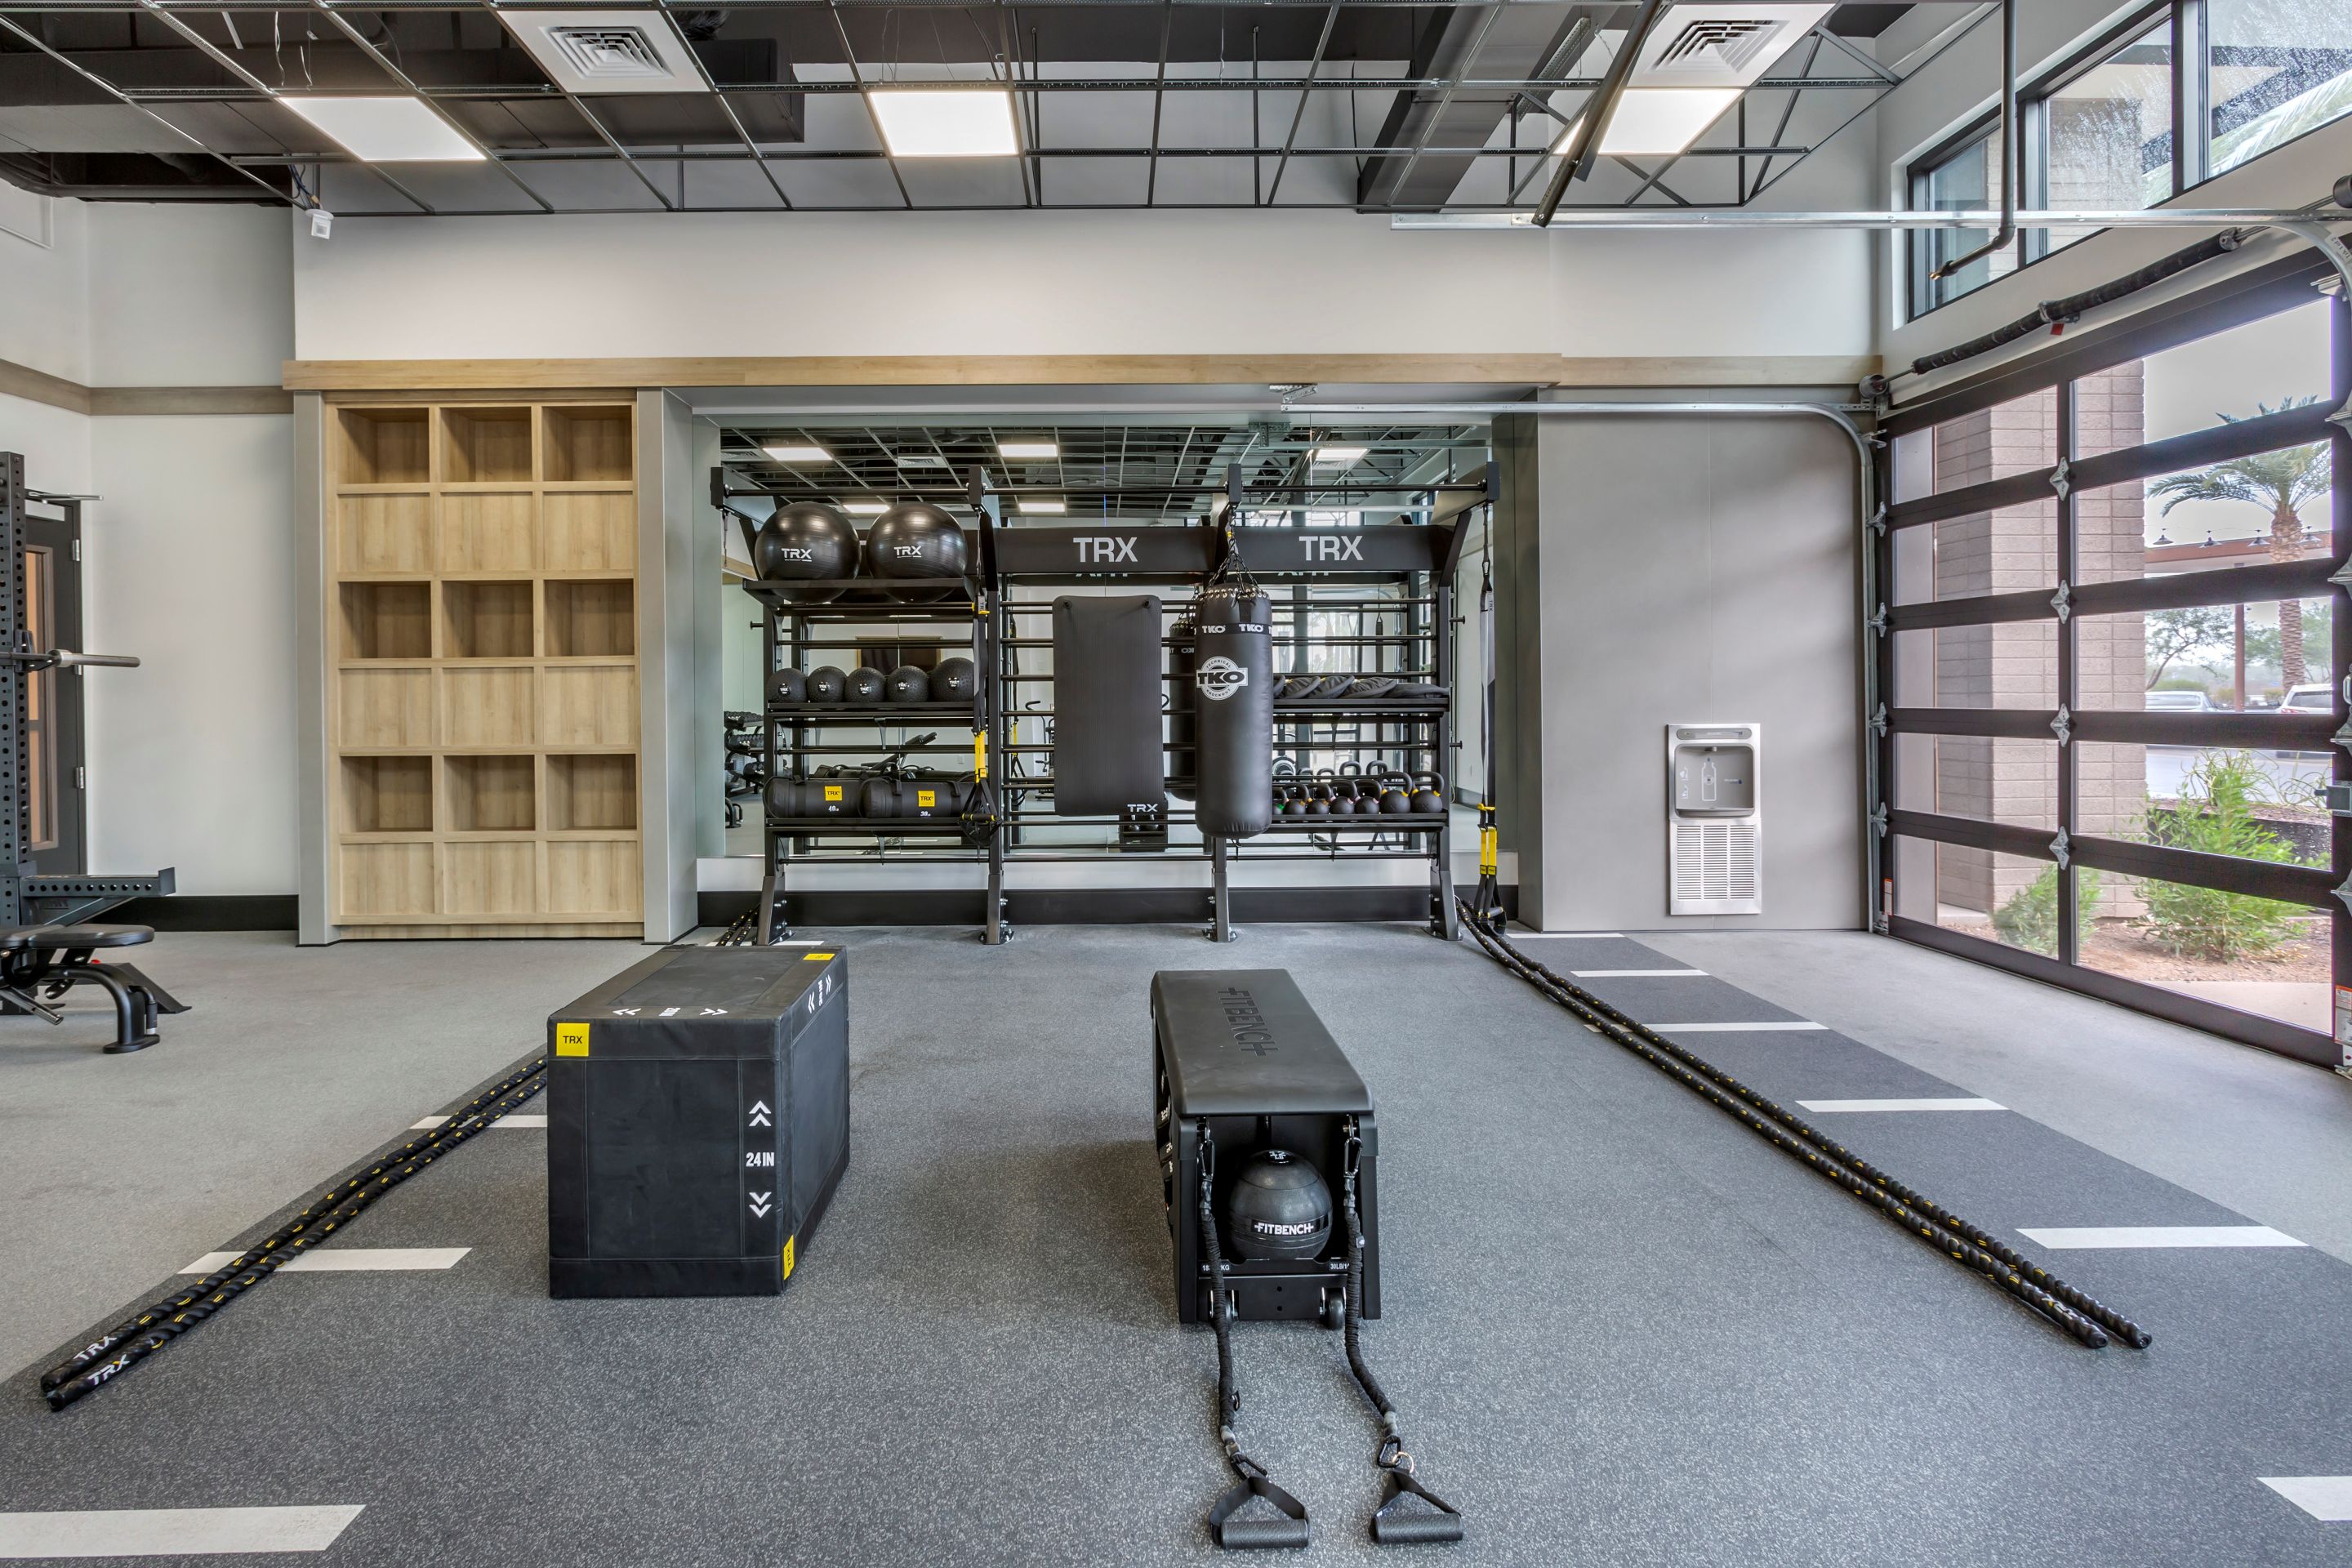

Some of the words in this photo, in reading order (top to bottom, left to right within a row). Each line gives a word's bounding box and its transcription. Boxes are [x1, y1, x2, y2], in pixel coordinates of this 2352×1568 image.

[782, 548, 812, 559] TRX
[893, 546, 922, 556] TRX
[1073, 537, 1138, 563] TRX
[1298, 536, 1364, 561] TRX
[1202, 626, 1226, 634] TKO
[1239, 623, 1263, 632] TKO
[1206, 659, 1232, 668] TECHNICAL
[1197, 670, 1245, 684] TKO
[1206, 688, 1232, 697] KNOCKOUT
[1127, 804, 1158, 813] TRX
[1218, 987, 1279, 1056] FITBENCH
[563, 1036, 582, 1044] TRX
[1254, 1222, 1314, 1236] FITBENCH
[73, 1335, 118, 1361] TRX
[87, 1353, 131, 1386] TRX
